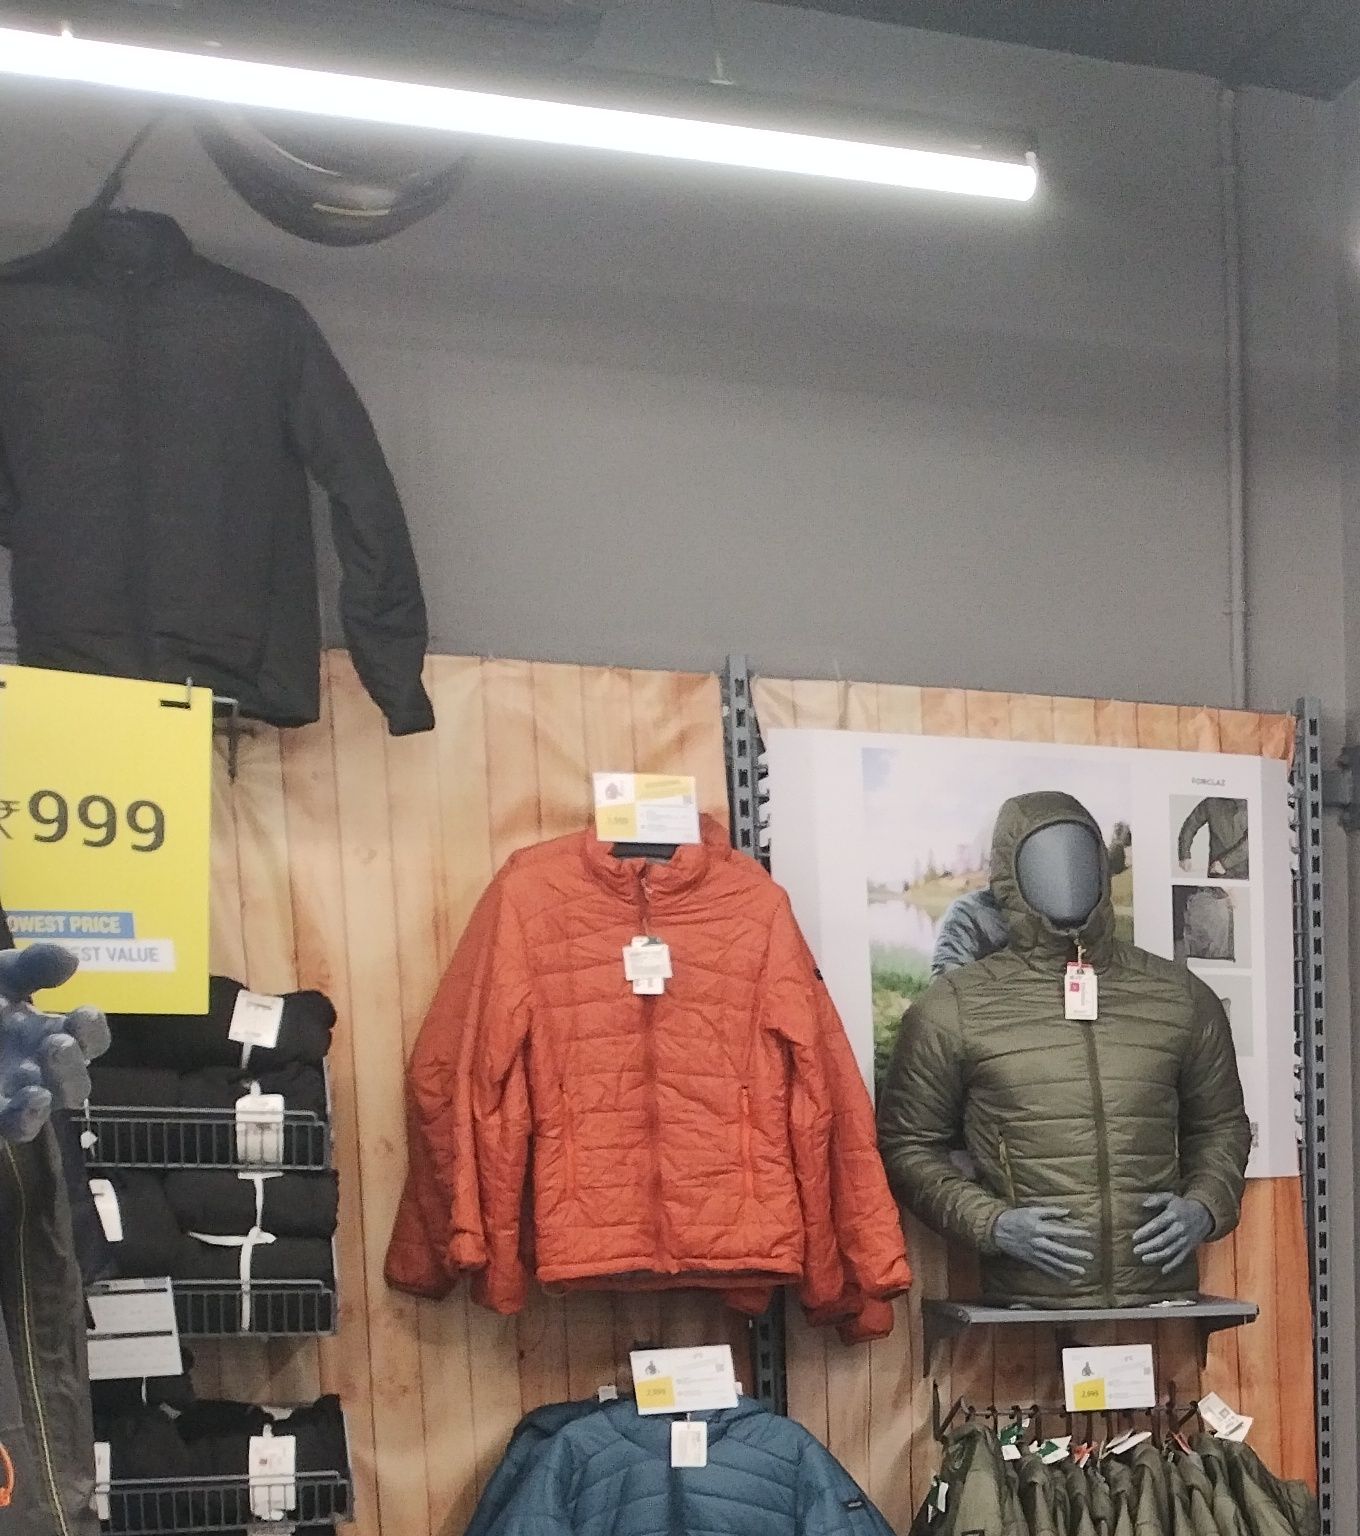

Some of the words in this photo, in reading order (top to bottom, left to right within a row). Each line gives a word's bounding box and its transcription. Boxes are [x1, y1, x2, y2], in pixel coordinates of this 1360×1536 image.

[7, 915, 65, 933] OWEST
[69, 916, 121, 934] PRICE
[106, 947, 159, 963] VALUE
